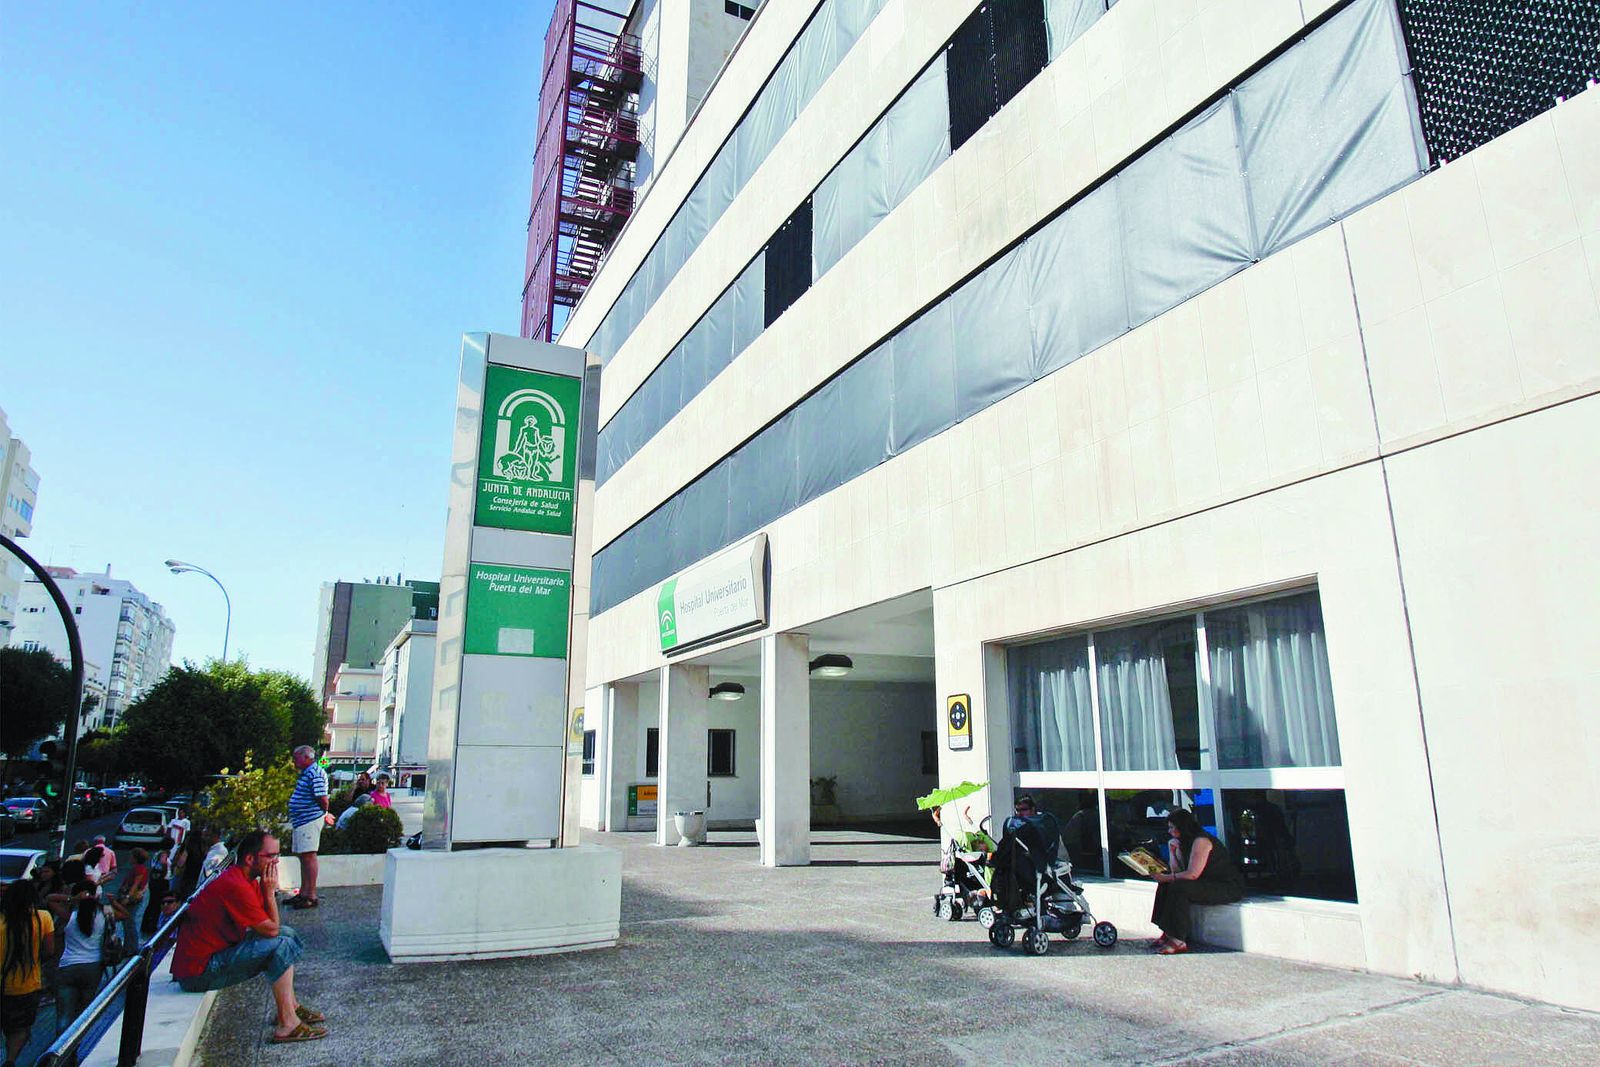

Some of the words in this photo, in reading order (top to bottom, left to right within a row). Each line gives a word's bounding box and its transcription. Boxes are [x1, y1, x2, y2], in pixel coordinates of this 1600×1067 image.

[483, 482, 509, 494] JUNTA
[512, 486, 523, 496] DE
[490, 504, 512, 512] Servicio
[530, 500, 538, 508] de
[541, 501, 558, 509] Salud
[476, 571, 510, 582] Hospital
[514, 574, 564, 586] Universitario
[489, 582, 516, 593] Puerta
[518, 585, 532, 594] del
[535, 586, 552, 596] Mar
[680, 592, 704, 615] Hospital
[704, 576, 747, 604] Universitario
